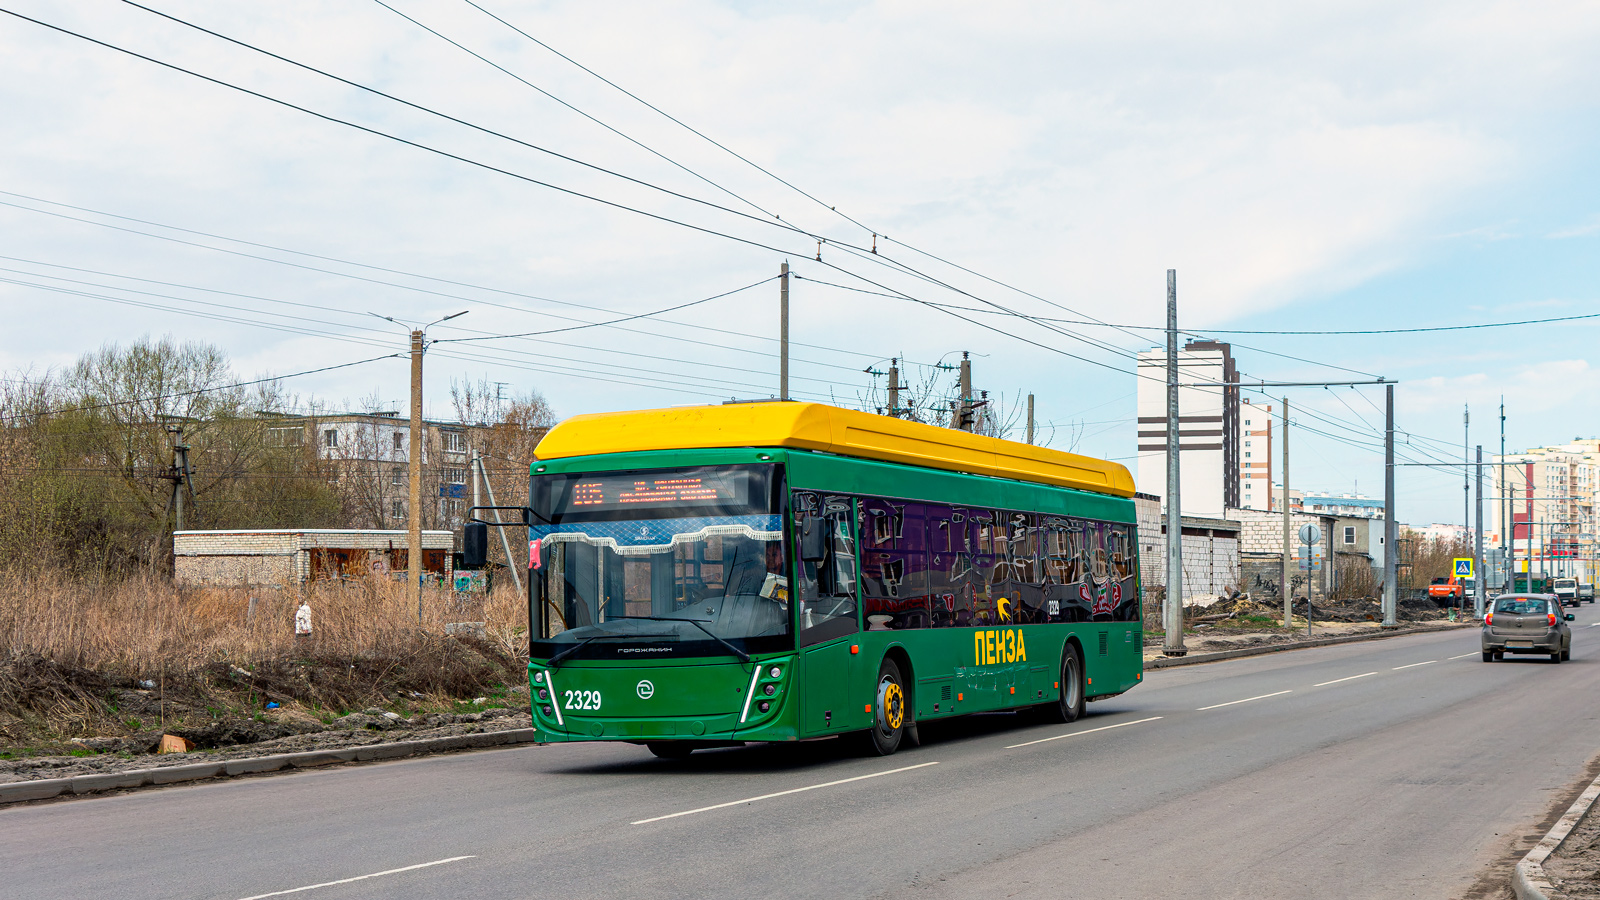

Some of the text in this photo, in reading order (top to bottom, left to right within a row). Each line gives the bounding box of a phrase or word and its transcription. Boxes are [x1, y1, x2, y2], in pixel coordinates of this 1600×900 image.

[574, 483, 603, 505] 105
[974, 628, 1026, 666] ПЕНЗА
[566, 690, 602, 711] 2329
